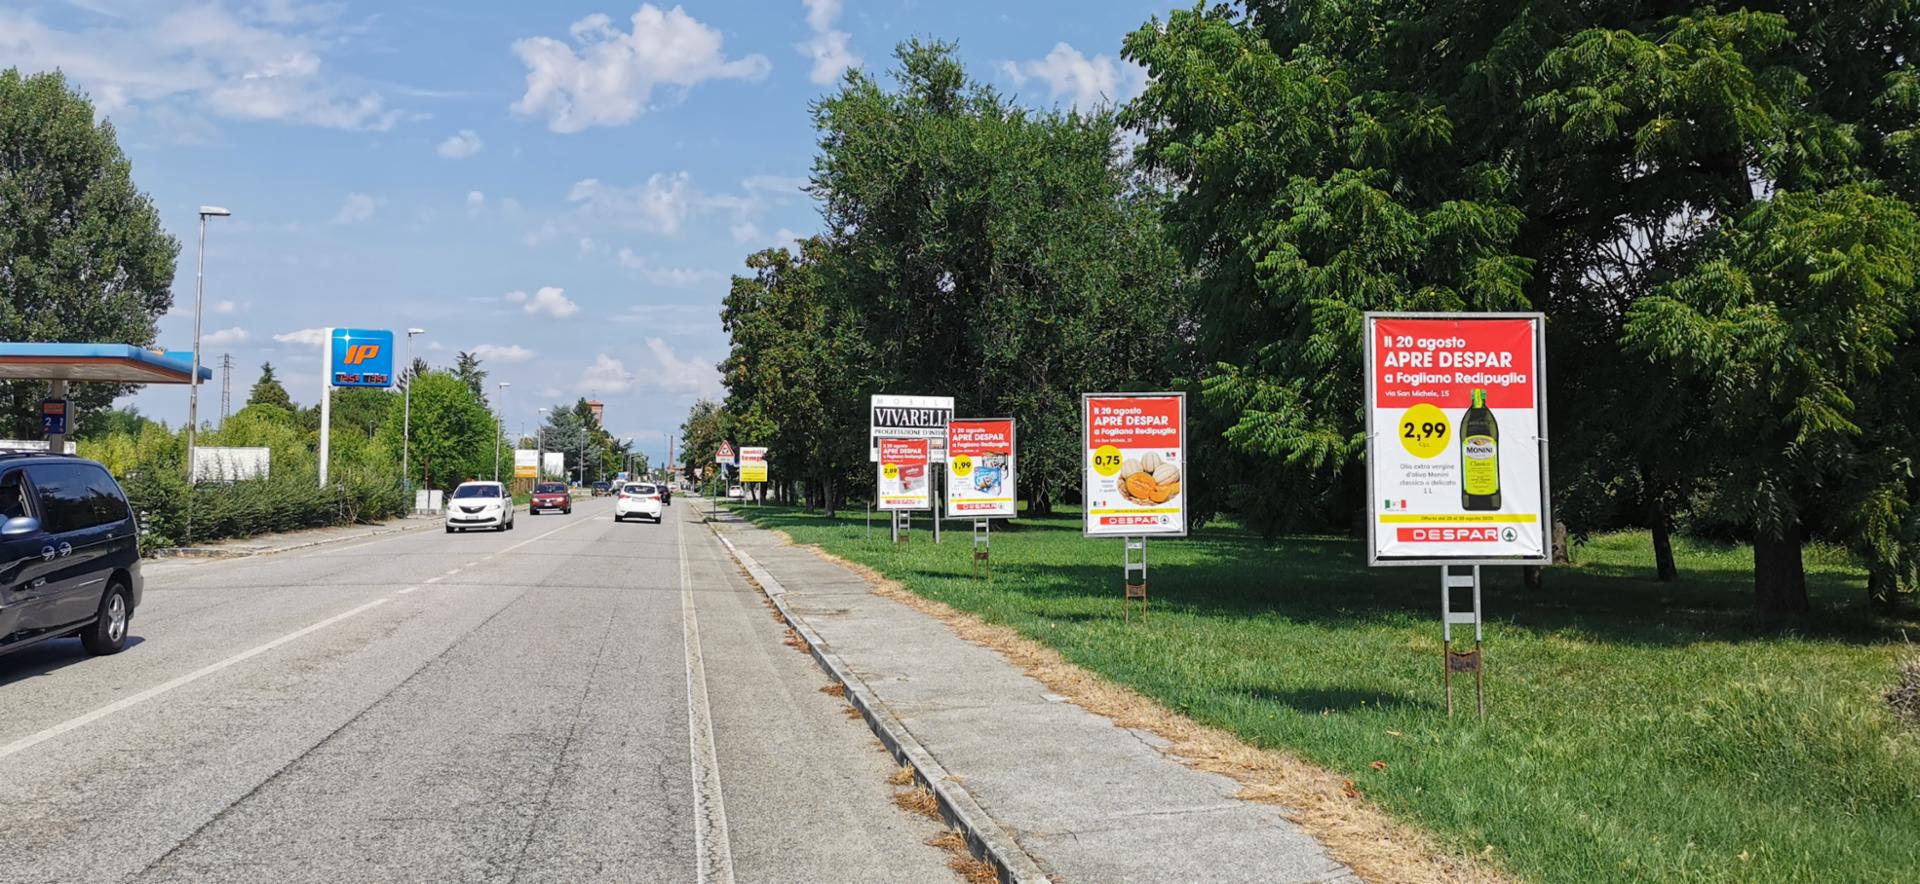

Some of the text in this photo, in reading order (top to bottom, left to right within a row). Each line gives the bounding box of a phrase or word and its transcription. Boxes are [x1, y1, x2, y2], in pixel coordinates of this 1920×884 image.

[1384, 336, 1466, 351] Il 20 agosto
[344, 345, 380, 365] IP
[1384, 351, 1513, 368] APRE DESPAR
[1384, 372, 1526, 386] a Fogliano Redipuglia
[1094, 416, 1168, 425] APRE DESPAR
[953, 433, 1004, 441] APRE DESPAR
[1404, 422, 1446, 441] 2,99
[1095, 456, 1120, 466] 0,75
[1413, 529, 1497, 540] DESPAR
